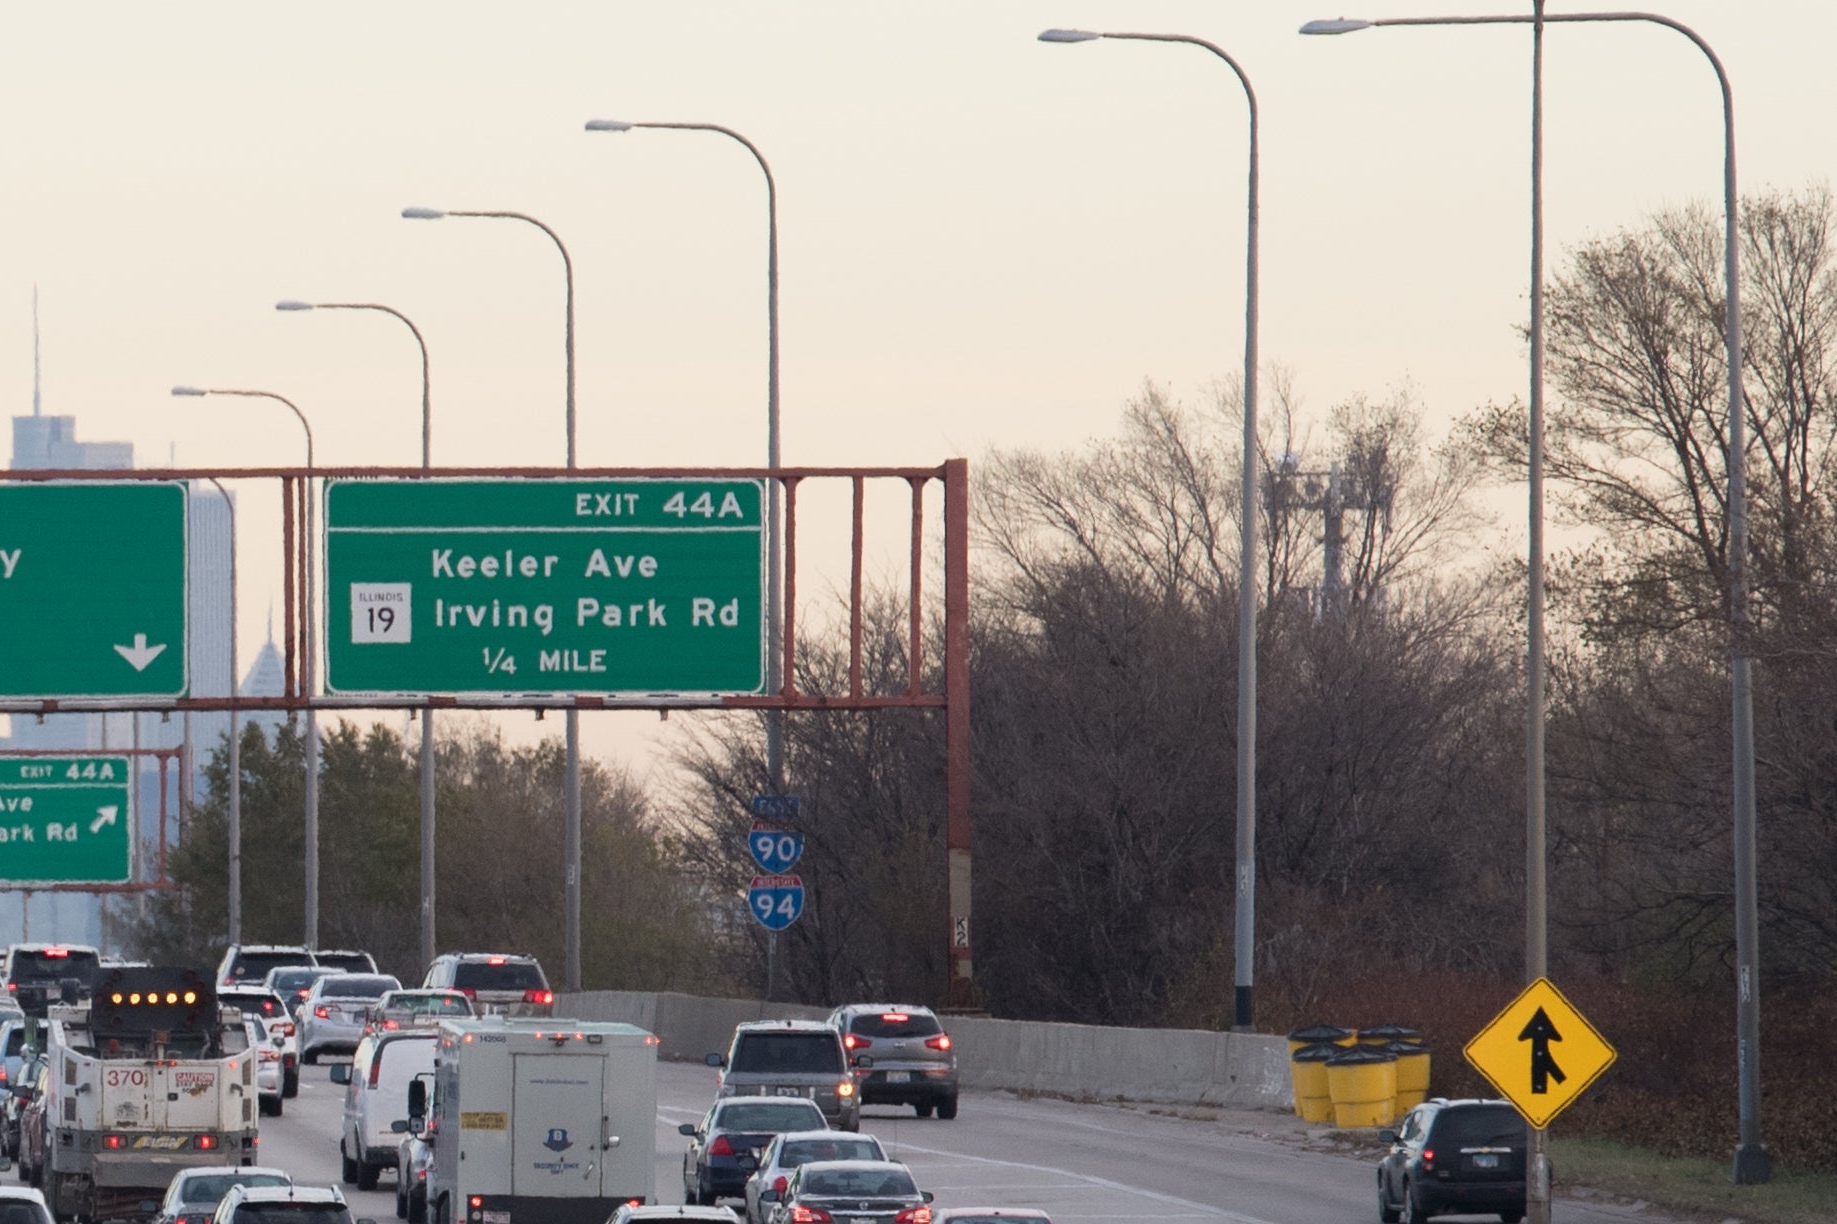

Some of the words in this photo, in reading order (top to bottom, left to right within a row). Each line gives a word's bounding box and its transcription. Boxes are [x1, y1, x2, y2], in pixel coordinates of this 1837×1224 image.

[577, 494, 639, 515] EXIT
[663, 492, 743, 517] 44A
[433, 550, 558, 577] Keeler
[585, 549, 657, 577] Ave
[359, 593, 403, 602] ILLINOIS
[368, 608, 394, 632] 19
[437, 599, 552, 635] Irving
[578, 598, 666, 626] Park
[693, 598, 738, 626] Rd
[540, 650, 606, 671] MILE
[21, 766, 52, 777] EXIT
[67, 763, 113, 779] 44A
[47, 823, 77, 841] Rd
[757, 837, 794, 861] 90
[755, 894, 794, 922] 94
[107, 1069, 144, 1087] 370
[176, 1073, 215, 1082] CAUTION
